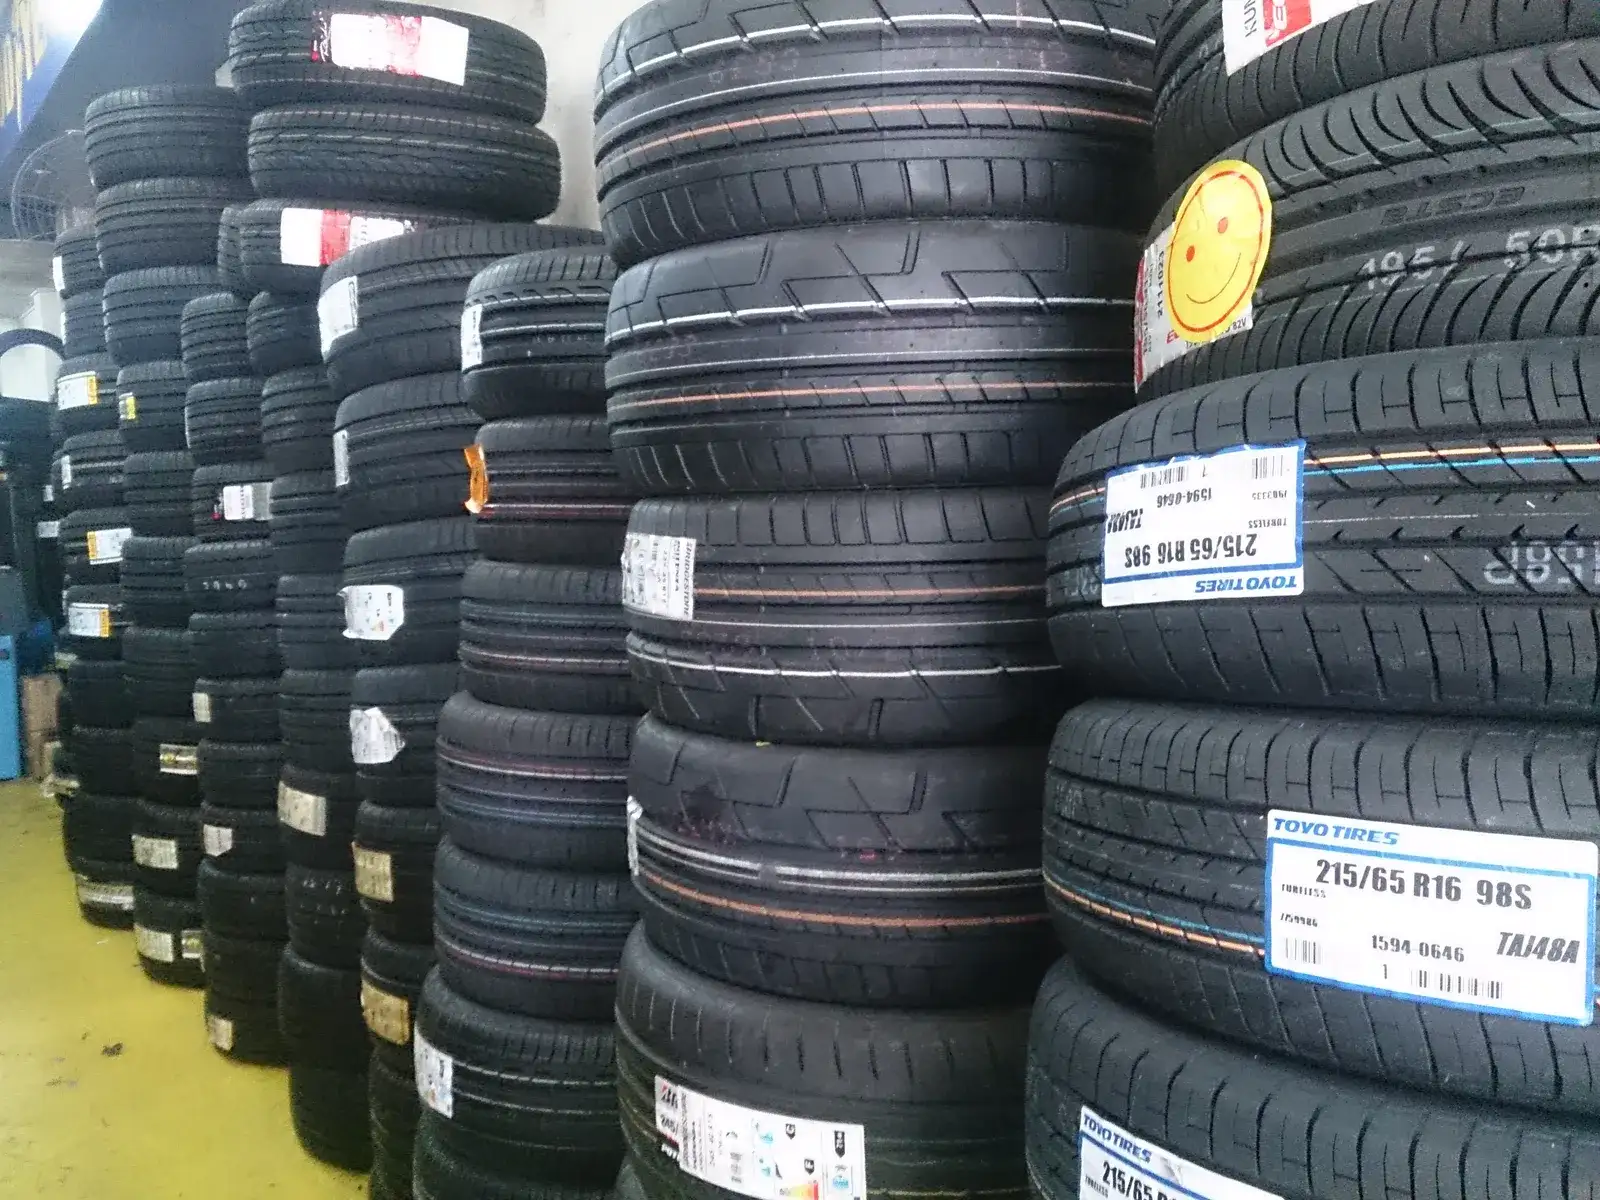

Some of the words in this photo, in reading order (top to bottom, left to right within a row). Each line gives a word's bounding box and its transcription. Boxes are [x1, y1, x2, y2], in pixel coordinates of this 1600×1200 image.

[1124, 544, 1151, 568] 98S
[1157, 540, 1185, 565] R16
[1190, 533, 1258, 562] 215/65
[1195, 578, 1244, 593] TIRES
[1246, 575, 1297, 590] TOYO
[1274, 817, 1328, 837] TOYO
[1332, 824, 1400, 846] TIRES
[1316, 859, 1406, 895] 215/65
[1413, 872, 1462, 902] R16
[1476, 879, 1532, 911] 98S
[1496, 931, 1581, 964] TAJ48A
[1083, 1114, 1112, 1141] TOYO
[1113, 1133, 1153, 1163] TIRES
